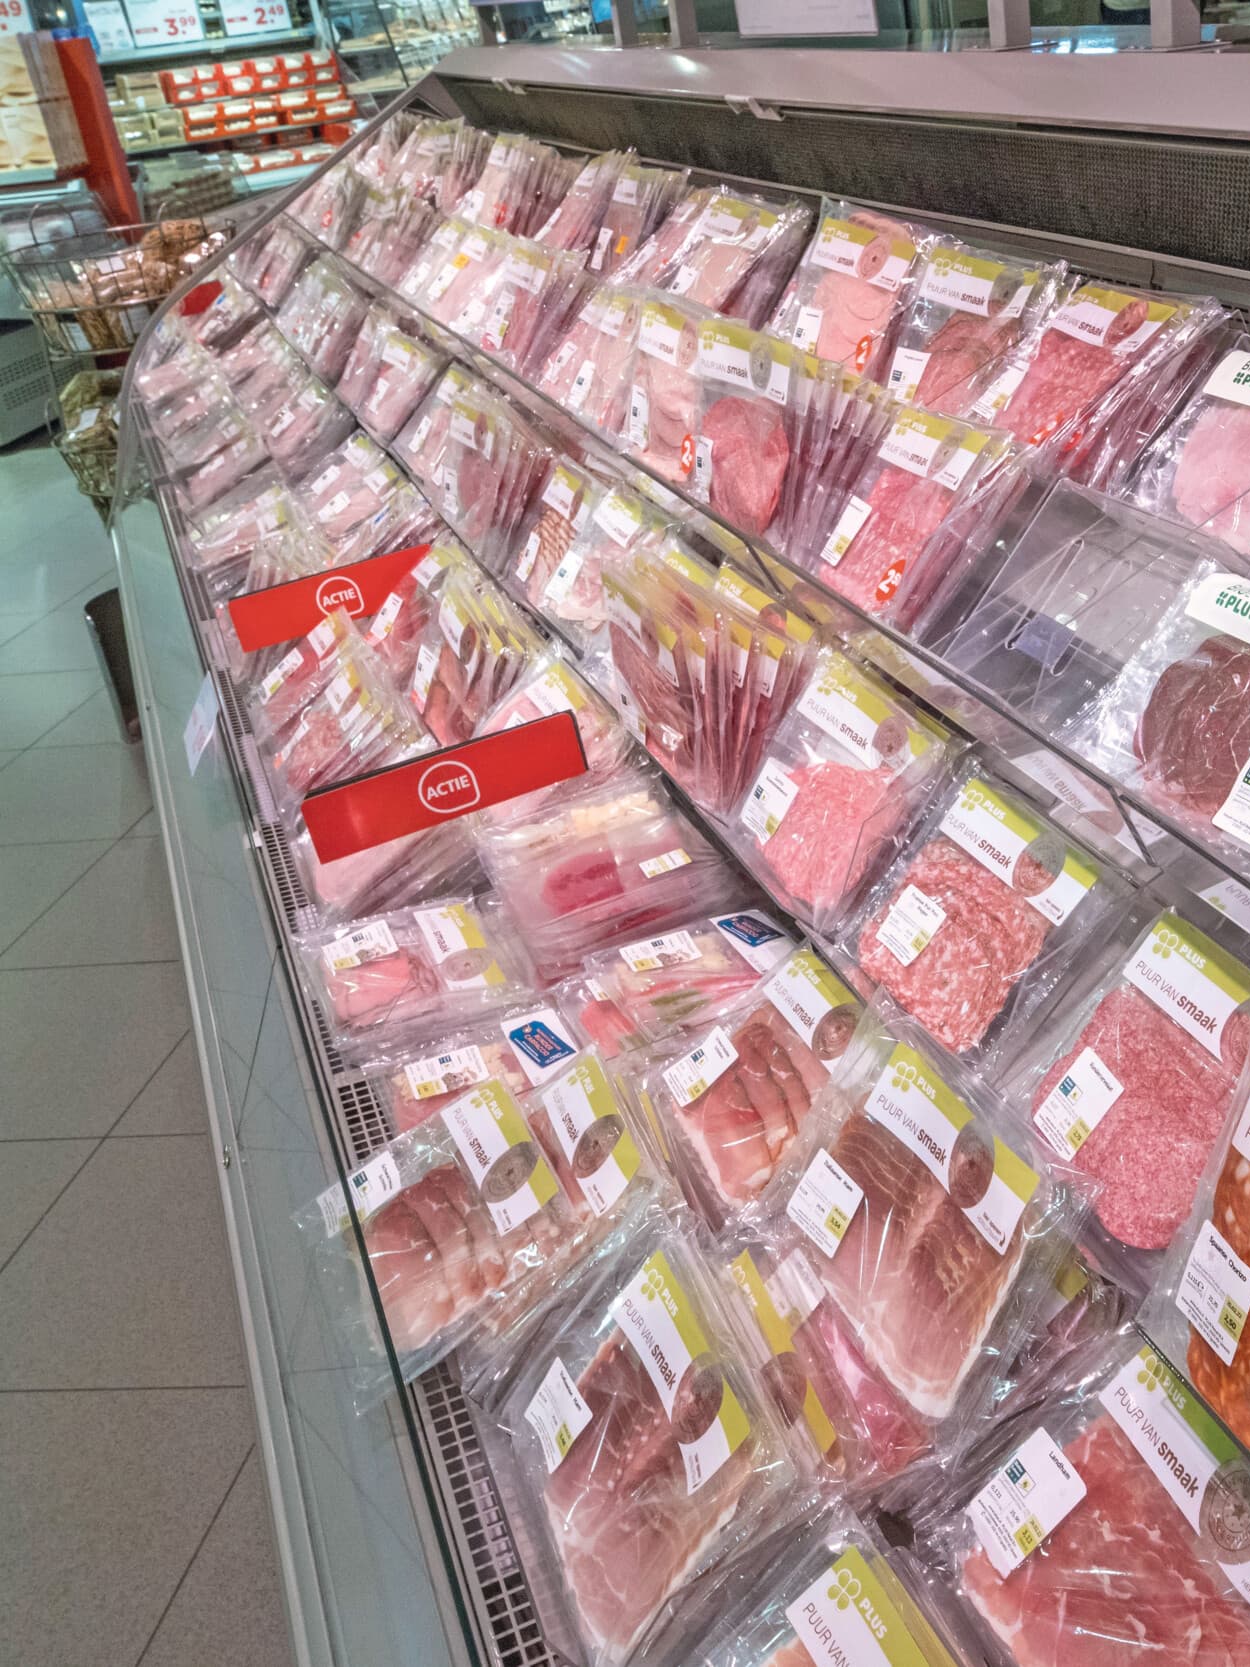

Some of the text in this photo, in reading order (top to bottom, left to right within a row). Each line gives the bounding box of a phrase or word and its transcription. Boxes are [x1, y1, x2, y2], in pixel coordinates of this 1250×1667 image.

[960, 292, 985, 306] smaak
[1078, 321, 1104, 337] smaak
[726, 366, 749, 379] smaak
[322, 588, 357, 607] ACTIE
[839, 722, 869, 750] smaak
[426, 774, 472, 801] ACTIE
[977, 838, 1013, 870] smaak
[1179, 944, 1207, 970] PLUS
[1136, 960, 1162, 984] PUUR
[1160, 978, 1180, 1002] VAN
[1177, 995, 1218, 1035] smaak
[792, 1003, 816, 1030] smaak
[917, 1075, 937, 1100] PLUS
[561, 1113, 580, 1144] smaak
[876, 1094, 948, 1167] PUUR VAN smaak
[469, 1137, 491, 1169] smaak
[661, 1288, 679, 1317] PLUS
[622, 1298, 676, 1391] PUUR VAN smaak
[1162, 1362, 1187, 1411] PLUS
[1115, 1386, 1201, 1500] PUUR VAN smaak
[1049, 1450, 1071, 1481] Landham
[802, 1602, 851, 1667] PUUR VAN
[859, 1597, 889, 1641] PLUS
